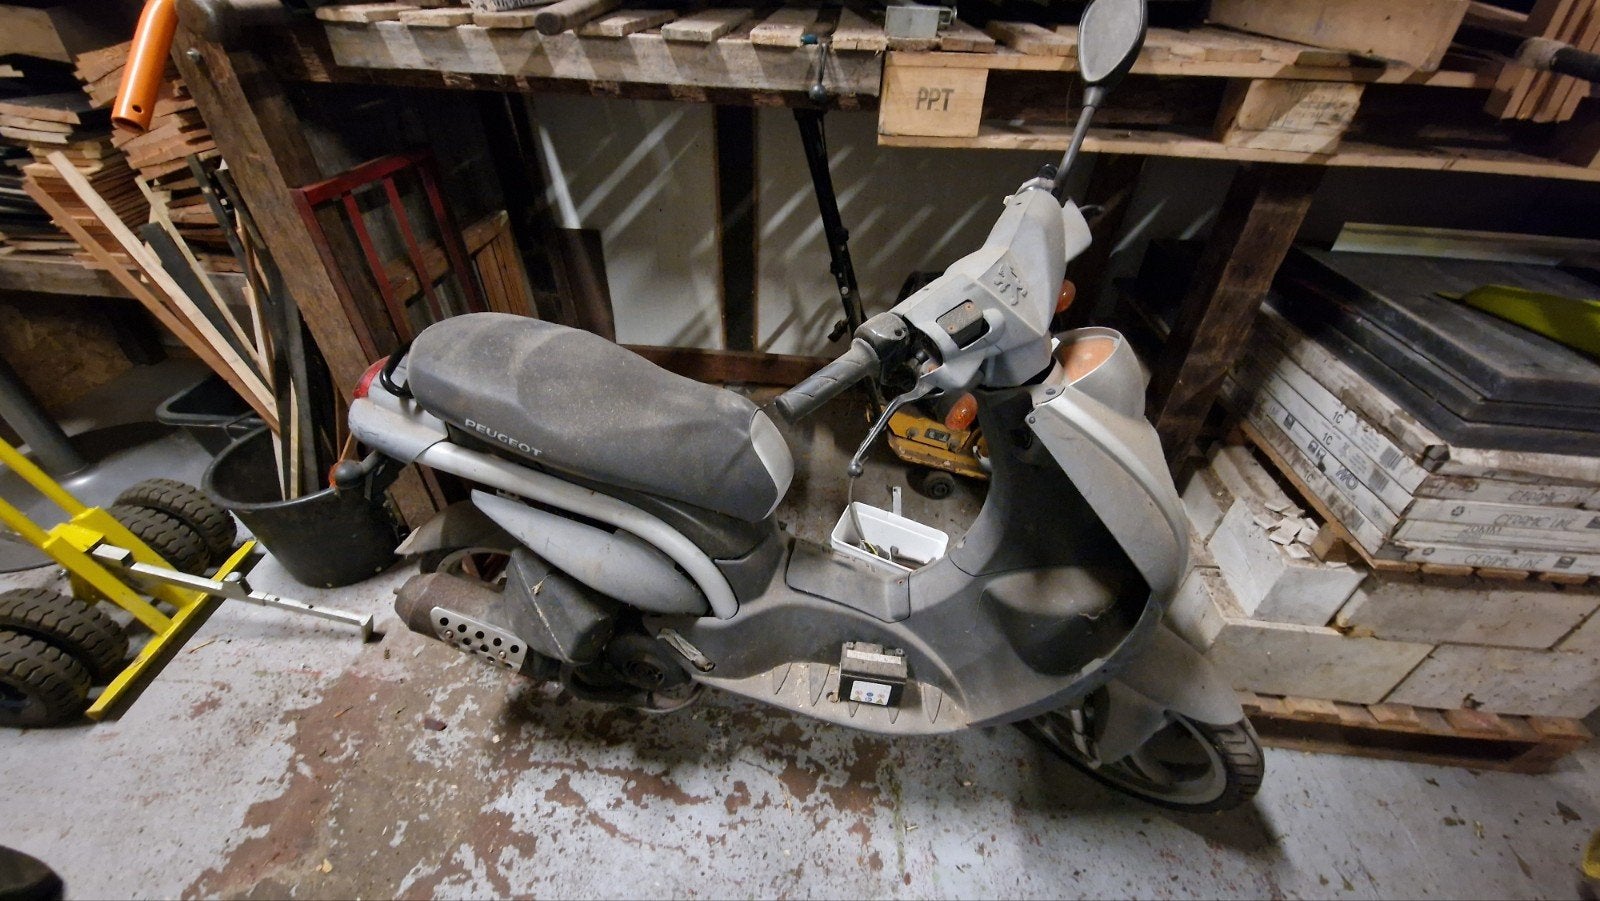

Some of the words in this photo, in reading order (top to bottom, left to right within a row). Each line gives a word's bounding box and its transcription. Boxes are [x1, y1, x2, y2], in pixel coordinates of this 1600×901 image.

[915, 86, 954, 111] PPT
[1332, 410, 1344, 425] 1C
[464, 418, 543, 456] PEUGEOT
[1322, 432, 1333, 446] 1C
